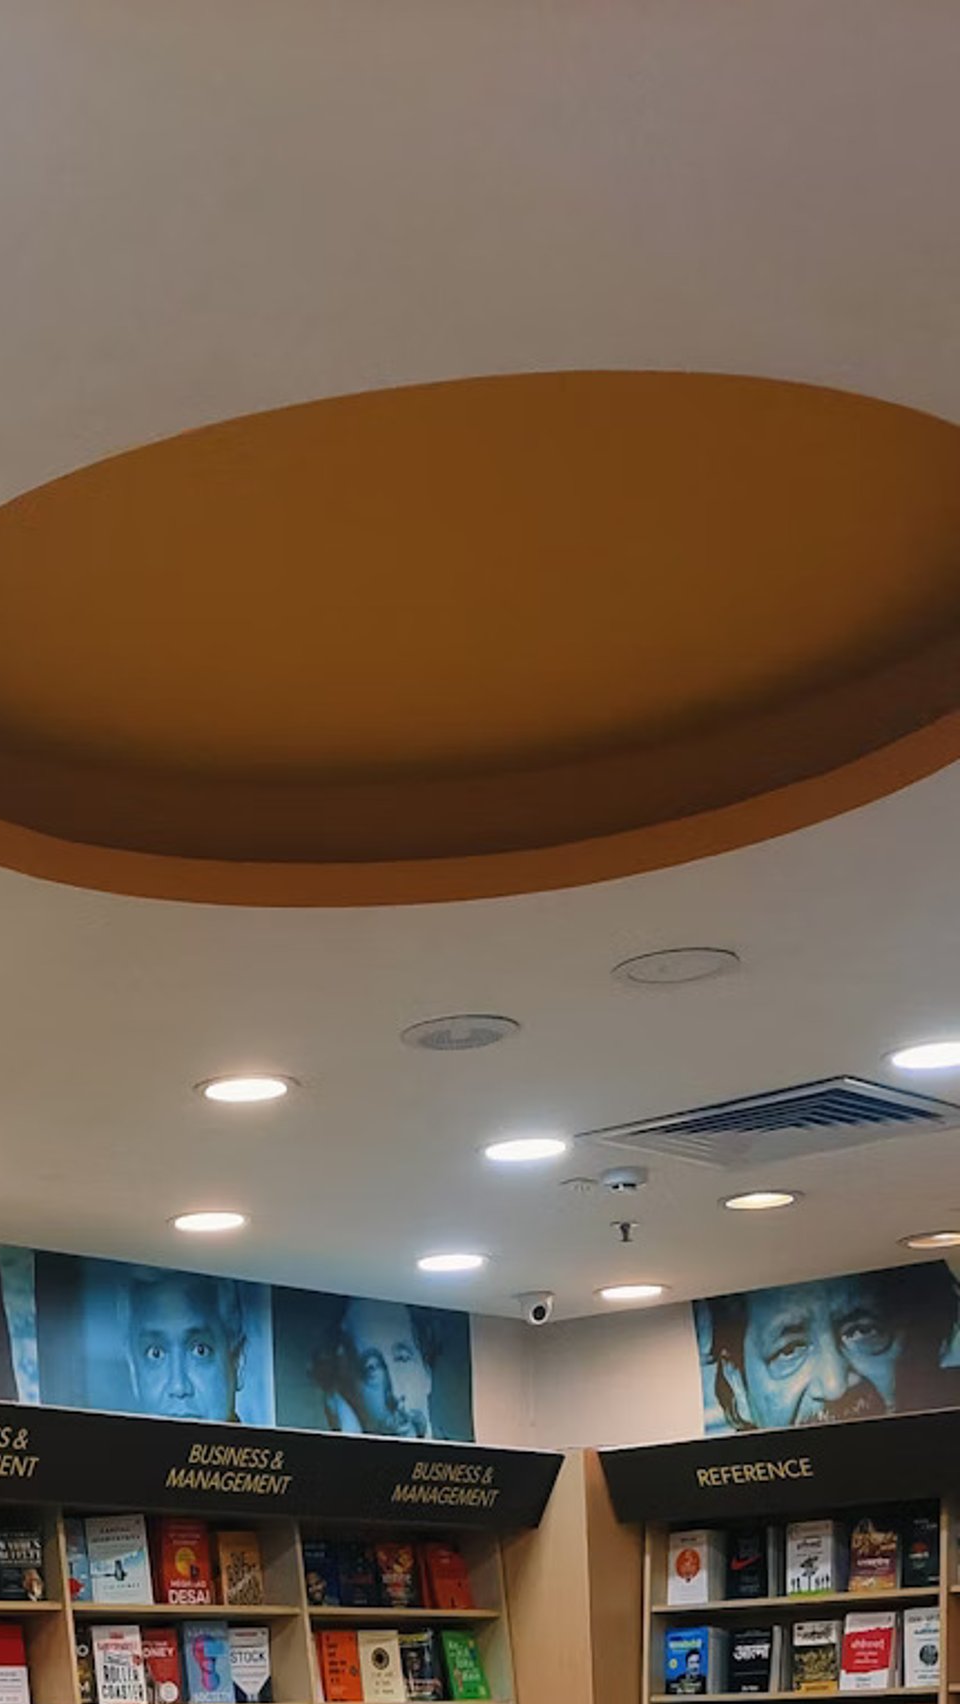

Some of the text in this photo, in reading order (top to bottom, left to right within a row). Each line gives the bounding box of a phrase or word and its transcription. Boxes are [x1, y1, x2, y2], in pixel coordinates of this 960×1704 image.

[13, 1429, 29, 1450] &
[188, 1444, 284, 1470] BUSINESS &
[166, 1469, 292, 1495] MANAGEMENT
[412, 1462, 494, 1485] BUSINESS &
[696, 1457, 814, 1488] REFERENCE
[391, 1483, 499, 1507] MANAGEMENT
[168, 1588, 211, 1605] DESAI
[230, 1650, 266, 1664] STOCK
